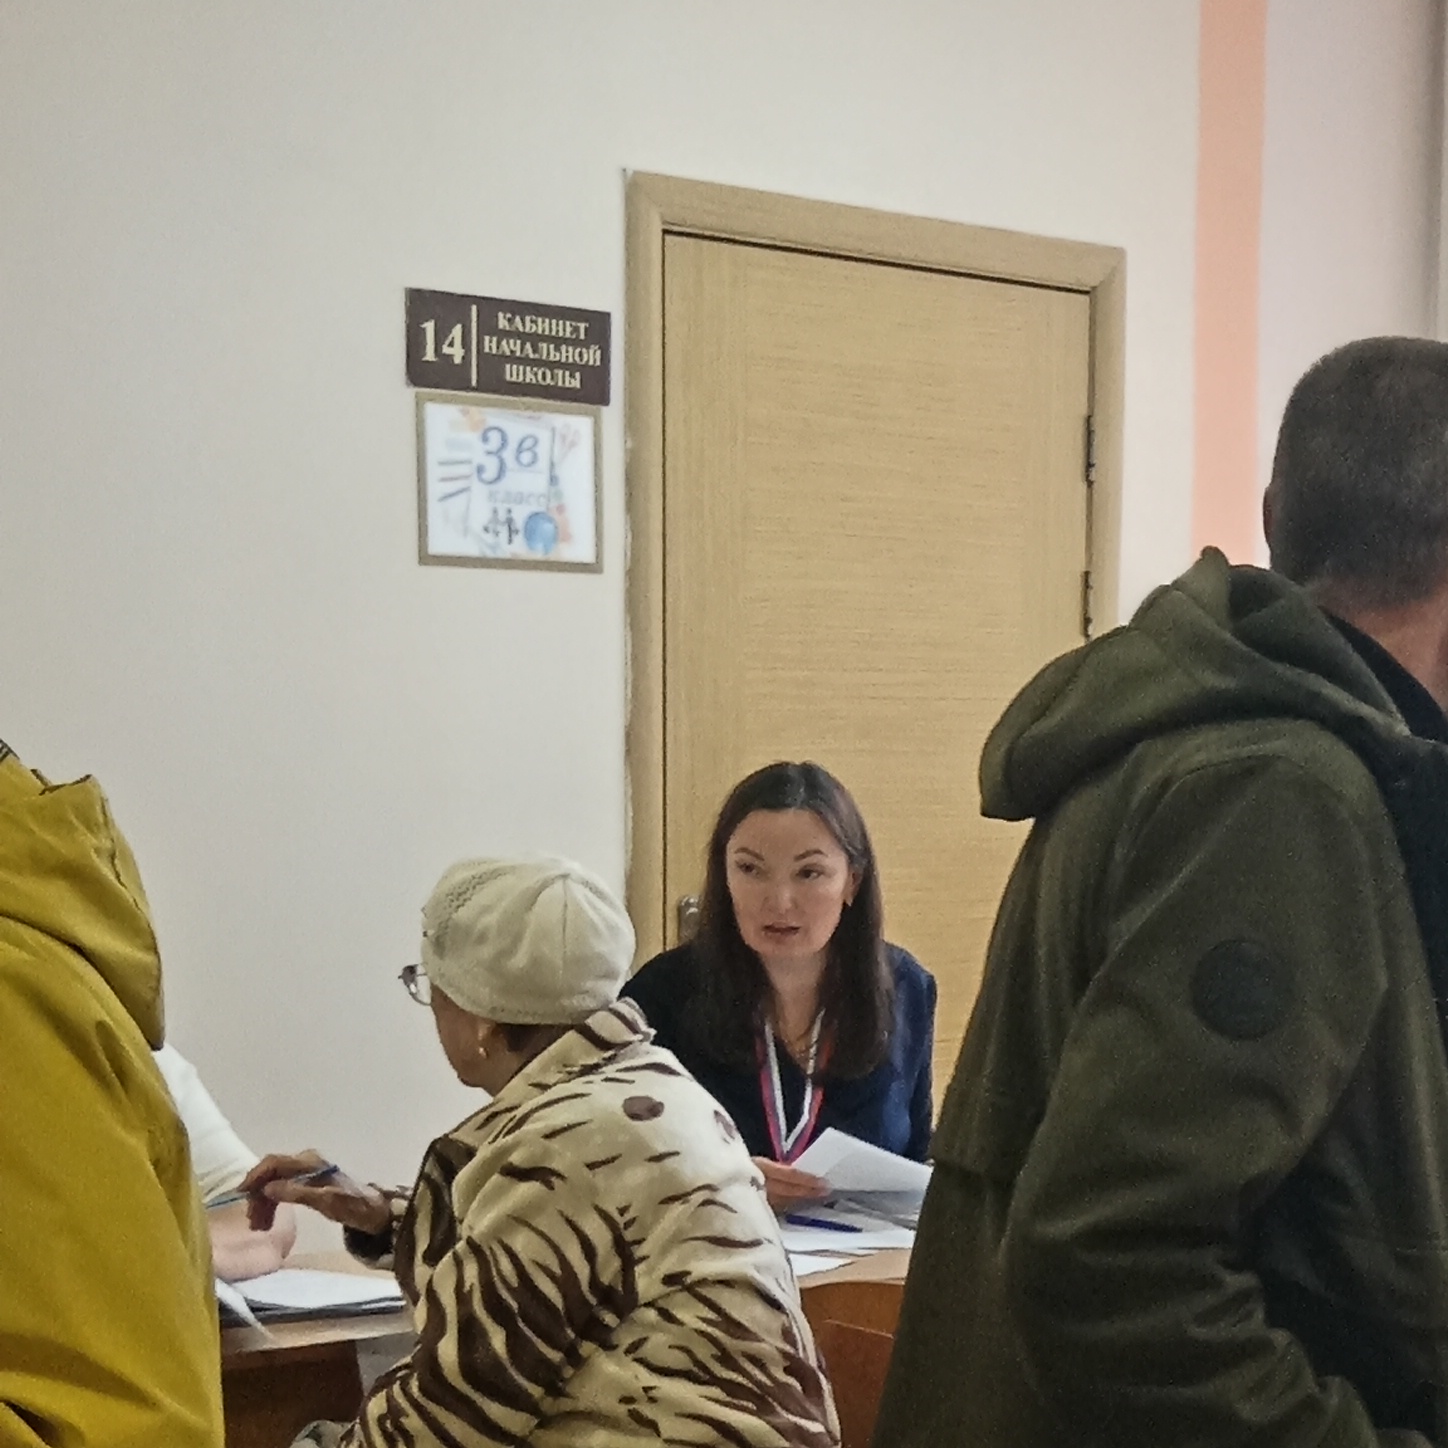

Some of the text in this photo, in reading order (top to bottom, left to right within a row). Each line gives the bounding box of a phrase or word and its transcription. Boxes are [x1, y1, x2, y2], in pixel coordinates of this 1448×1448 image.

[419, 318, 465, 365] 14
[497, 310, 589, 341] КАБИНЕТ
[483, 333, 602, 368] НАЧАЛЬНОЙ
[504, 362, 581, 390] ШКОЛЫ
